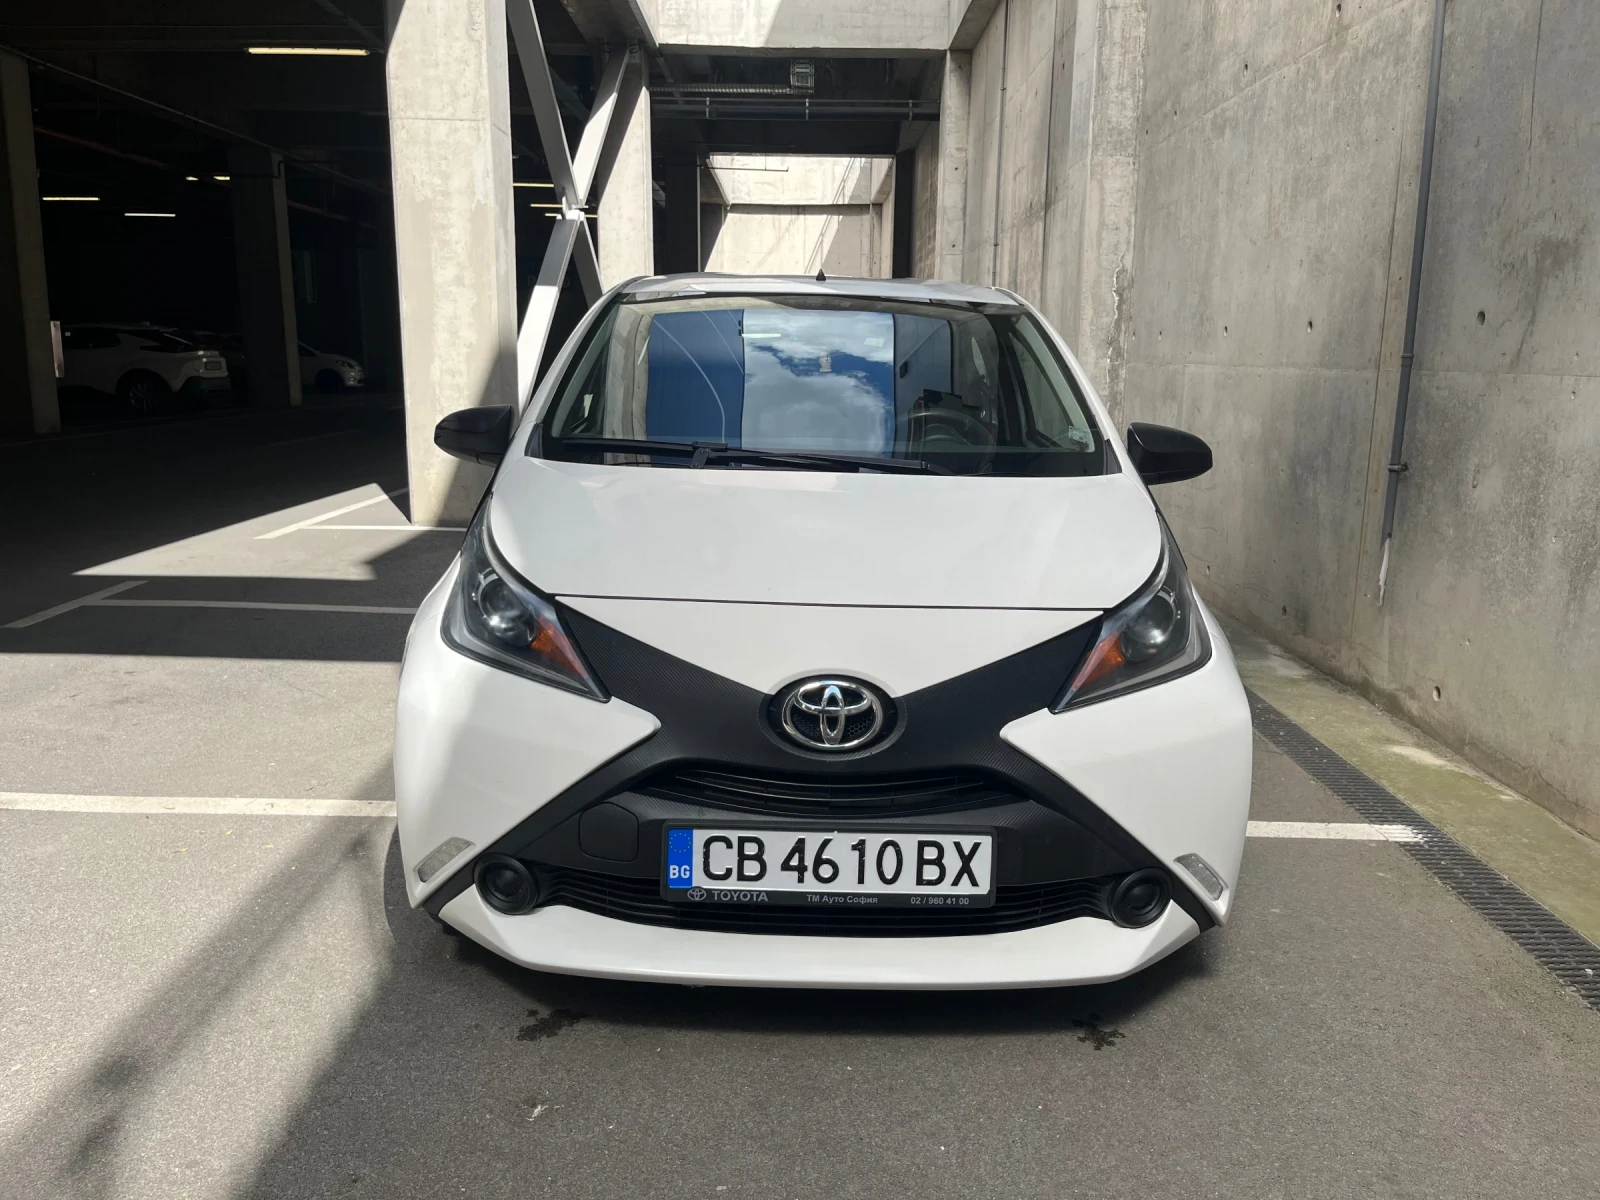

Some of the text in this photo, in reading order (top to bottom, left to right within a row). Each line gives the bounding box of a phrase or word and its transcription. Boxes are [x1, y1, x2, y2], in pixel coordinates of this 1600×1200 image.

[703, 835, 982, 887] CB 4610 BX
[669, 865, 690, 879] BG
[712, 890, 768, 902] TOYOTA
[822, 895, 844, 903] Ауто
[847, 895, 878, 904] София
[928, 897, 944, 905] 960
[946, 897, 957, 905] 41
[958, 897, 969, 905] 00
